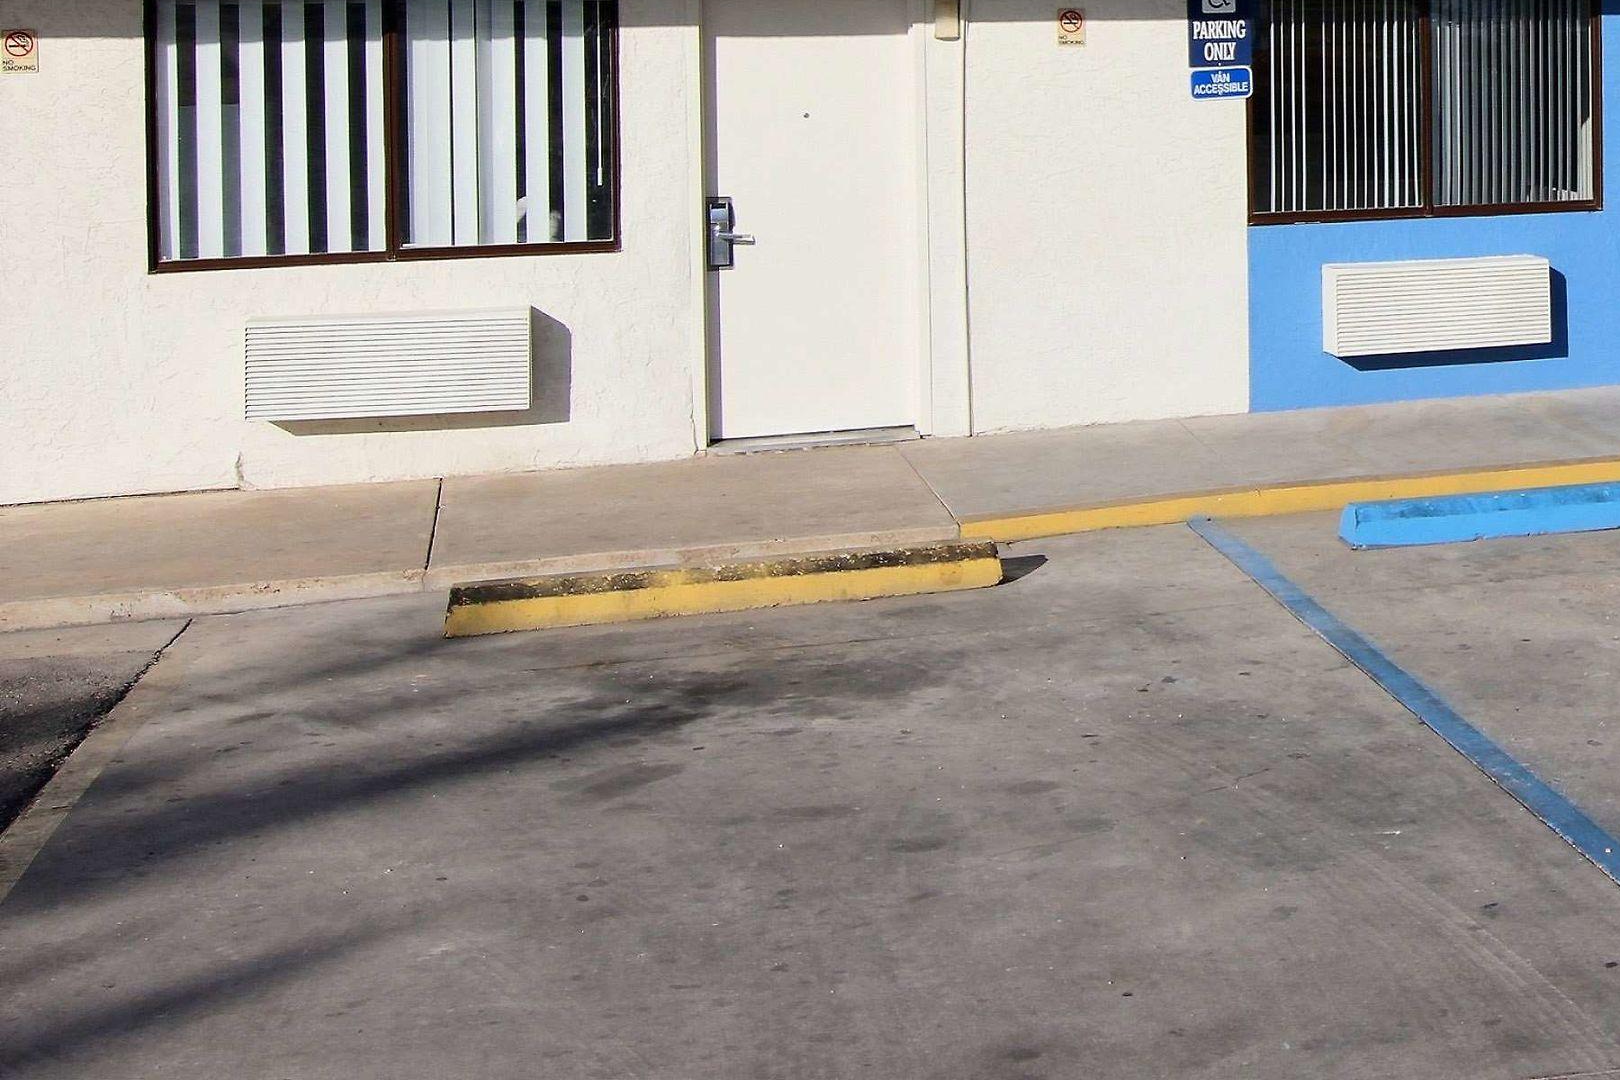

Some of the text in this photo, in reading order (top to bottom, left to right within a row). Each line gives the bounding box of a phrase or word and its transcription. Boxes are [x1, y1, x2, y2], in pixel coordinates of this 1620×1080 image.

[1192, 20, 1247, 40] PARKING
[1204, 41, 1237, 62] ONLY
[2, 64, 37, 72] SMOKING
[1210, 72, 1231, 84] VAN
[1193, 82, 1250, 96] ACCESSIBLE
